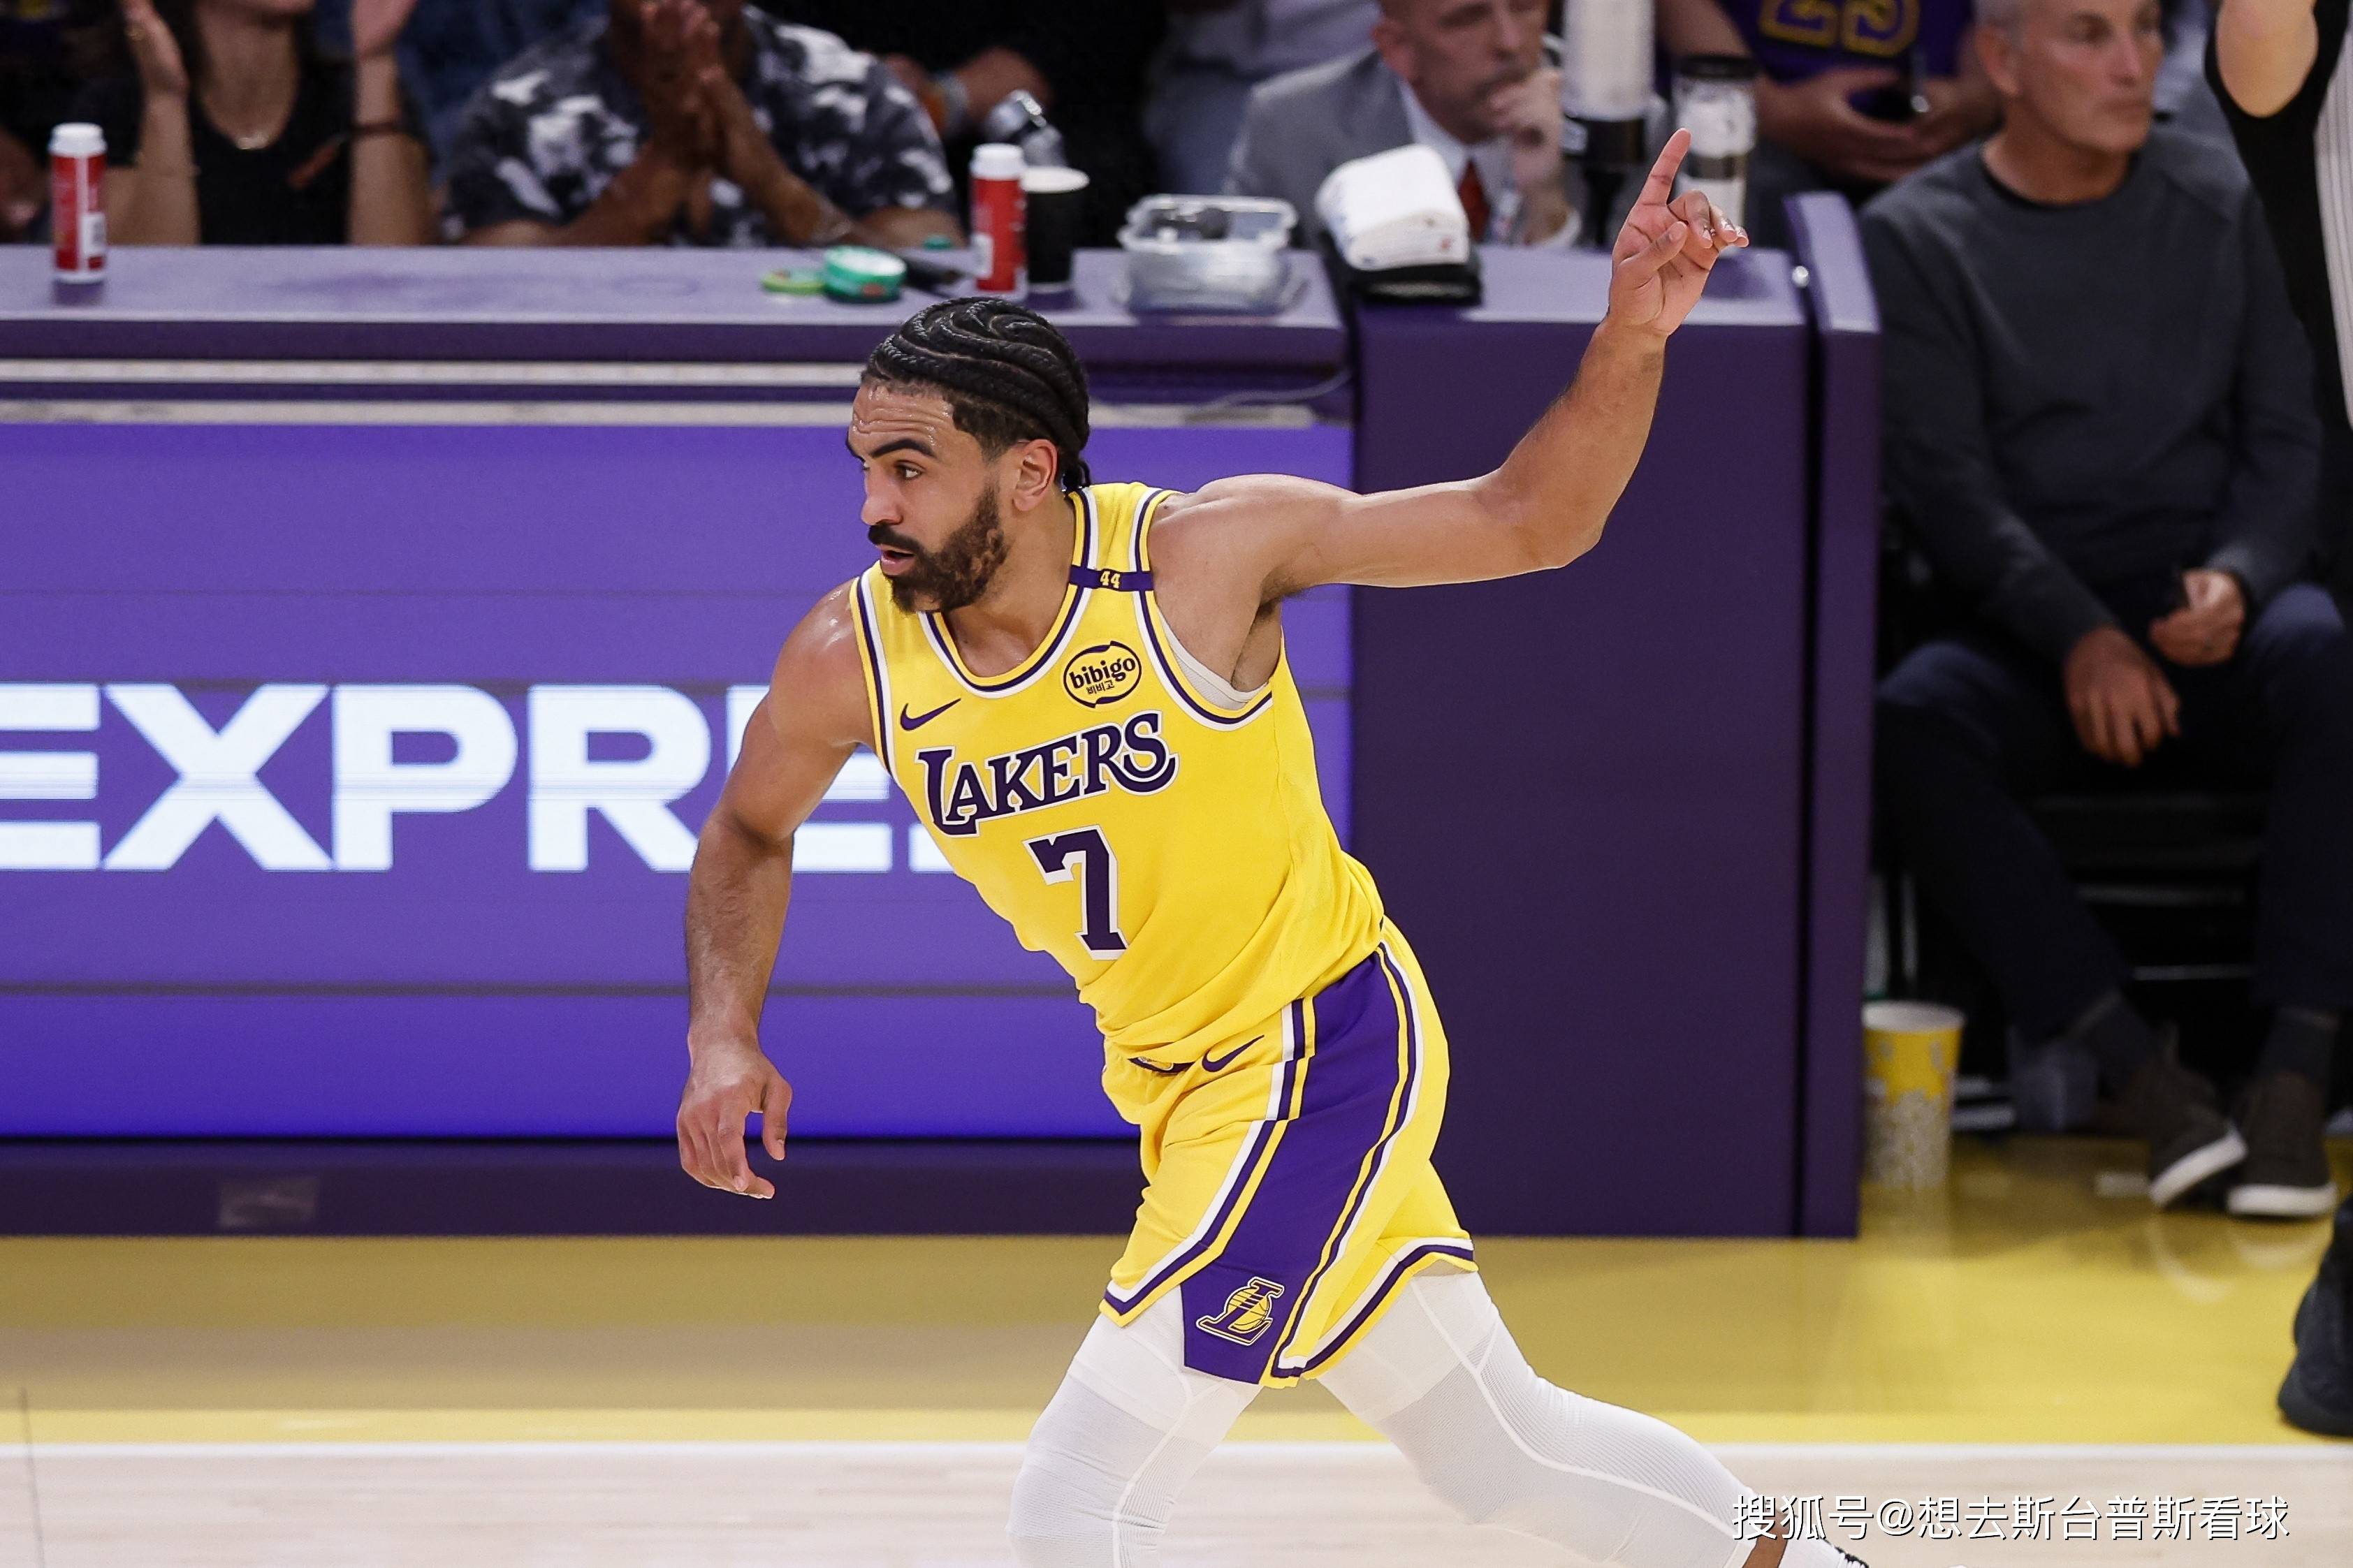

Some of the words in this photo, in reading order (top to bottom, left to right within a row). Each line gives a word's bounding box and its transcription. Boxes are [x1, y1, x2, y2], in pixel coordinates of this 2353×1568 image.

[1100, 570, 1121, 589] 44
[1069, 657, 1136, 689] bibigo
[1086, 680, 1115, 695] 비비고
[0, 682, 954, 872] EXPR
[915, 710, 1179, 837] LAKERS
[1022, 825, 1128, 961] 7
